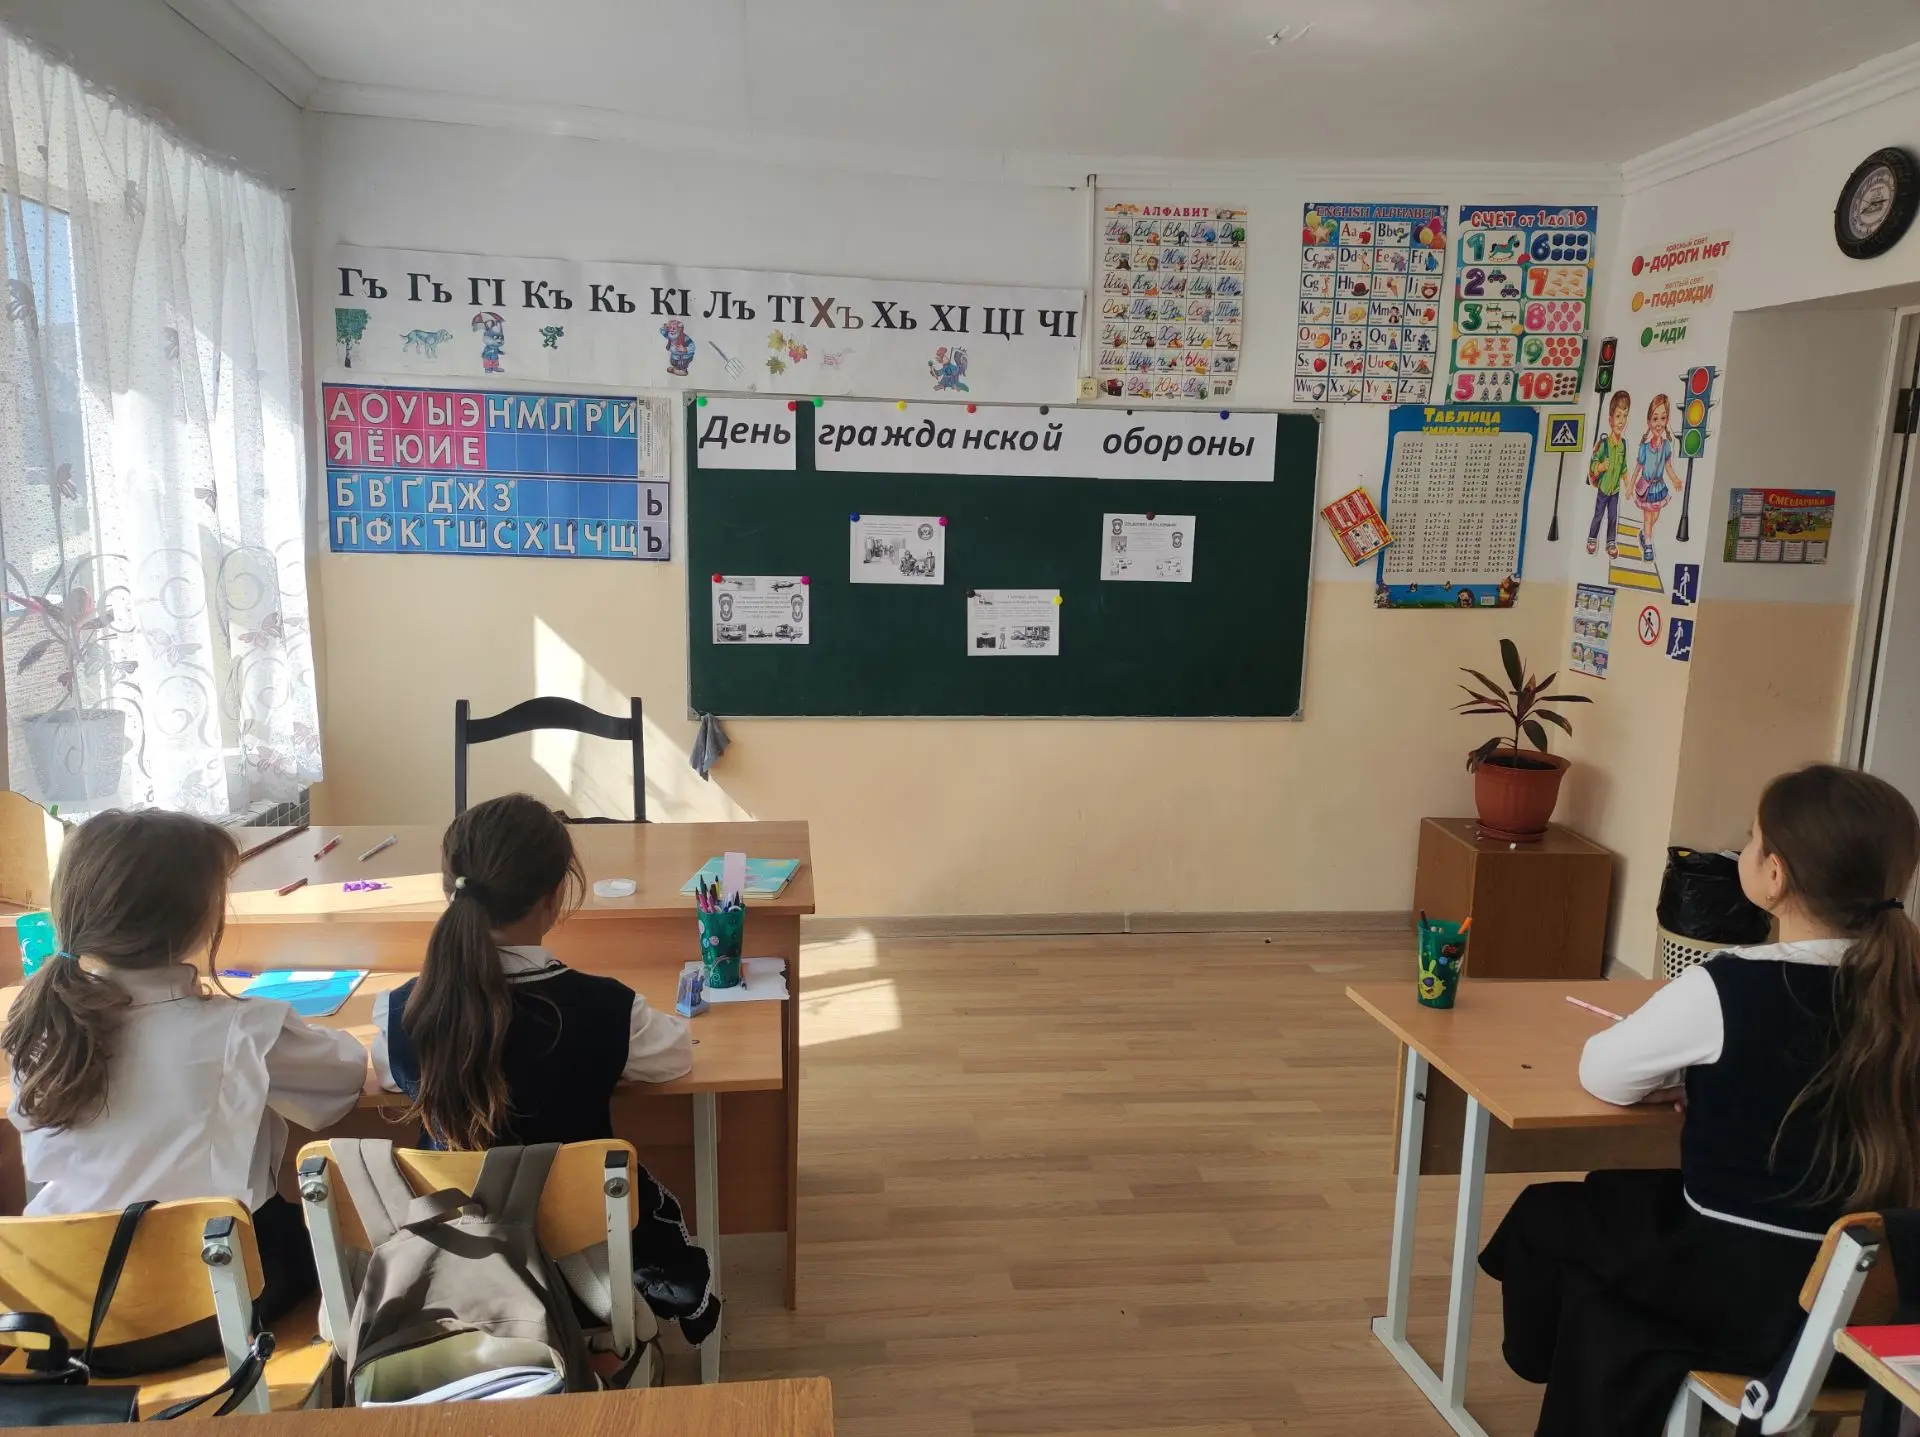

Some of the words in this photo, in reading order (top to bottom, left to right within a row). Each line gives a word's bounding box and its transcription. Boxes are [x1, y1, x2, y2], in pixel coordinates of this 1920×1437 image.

[1143, 206, 1209, 217] АЛФАВИТ
[1317, 206, 1369, 217] ENGLISH
[1374, 206, 1436, 218] ALPHABET
[1472, 211, 1516, 227] СЧЕТ
[1538, 210, 1546, 226] 1
[1568, 211, 1587, 226] 10
[1342, 223, 1356, 236] Aa
[1379, 223, 1392, 237] Bb
[1304, 248, 1318, 262] Cc
[1341, 248, 1357, 263] Dd
[1376, 249, 1390, 263] Ee
[1412, 250, 1423, 264] Ff
[1467, 233, 1485, 261] 1
[1531, 233, 1550, 262] 6
[1702, 241, 1730, 259] нет
[1303, 274, 1318, 292] Gg
[1338, 275, 1353, 290] Hh
[1374, 276, 1381, 290] Ii
[1408, 277, 1418, 295] Jj
[1464, 268, 1485, 296] 2
[1528, 268, 1549, 296] 7
[338, 267, 388, 299] Гъ
[407, 272, 452, 303] Гь
[521, 280, 573, 310] Къ
[589, 284, 636, 314] Кь
[703, 290, 756, 320] Лъ
[871, 301, 917, 330] Хь
[1301, 301, 1314, 315] Kk
[1336, 302, 1346, 315] Ll
[1372, 303, 1389, 316] Mm
[1406, 303, 1422, 316] Nn
[1462, 303, 1483, 331] 3
[1525, 303, 1546, 331] 8
[1300, 327, 1316, 341] Oo
[1334, 328, 1347, 343] Pp
[1370, 328, 1387, 345] Qq
[1404, 329, 1416, 342] Rr
[1298, 353, 1309, 367] Ss
[1333, 353, 1343, 367] Tt
[1368, 355, 1384, 368] Uu
[1403, 355, 1416, 369] Vv
[1460, 338, 1481, 365] 4
[1524, 338, 1543, 364] 9
[1296, 379, 1312, 392] Ww
[1330, 379, 1344, 393] Xx
[1366, 380, 1379, 394] Yy
[1399, 380, 1413, 394] Zz
[1455, 374, 1475, 400] 5
[1519, 373, 1553, 400] 10
[330, 392, 355, 421] А
[361, 394, 388, 424] О
[395, 395, 417, 425] У
[428, 397, 452, 428] Ы
[460, 398, 480, 427] Э
[489, 399, 511, 429] Н
[517, 400, 546, 430] М
[550, 402, 573, 431] Л
[585, 402, 602, 432] Р
[612, 402, 636, 434] Й
[334, 431, 353, 460] Я
[368, 429, 385, 462] Ё
[397, 435, 423, 464] Ю
[429, 434, 451, 464] И
[463, 437, 479, 465] Е
[699, 415, 791, 449] День
[1102, 426, 1255, 461] обороны
[337, 478, 354, 507] Б
[369, 479, 386, 508] В
[401, 481, 417, 508] Г
[428, 482, 453, 513] Д
[458, 482, 485, 511] Ж
[493, 483, 510, 512] З
[647, 489, 662, 517] Ь
[336, 517, 358, 545] П
[366, 517, 392, 545] Ф
[401, 519, 421, 547] К
[433, 520, 451, 548] Т
[459, 521, 486, 548] Ш
[493, 522, 512, 550] С
[523, 522, 545, 550] Х
[554, 523, 576, 554] Ц
[584, 524, 601, 551] Ч
[611, 524, 637, 556] Щ
[643, 526, 662, 553] Ъ
